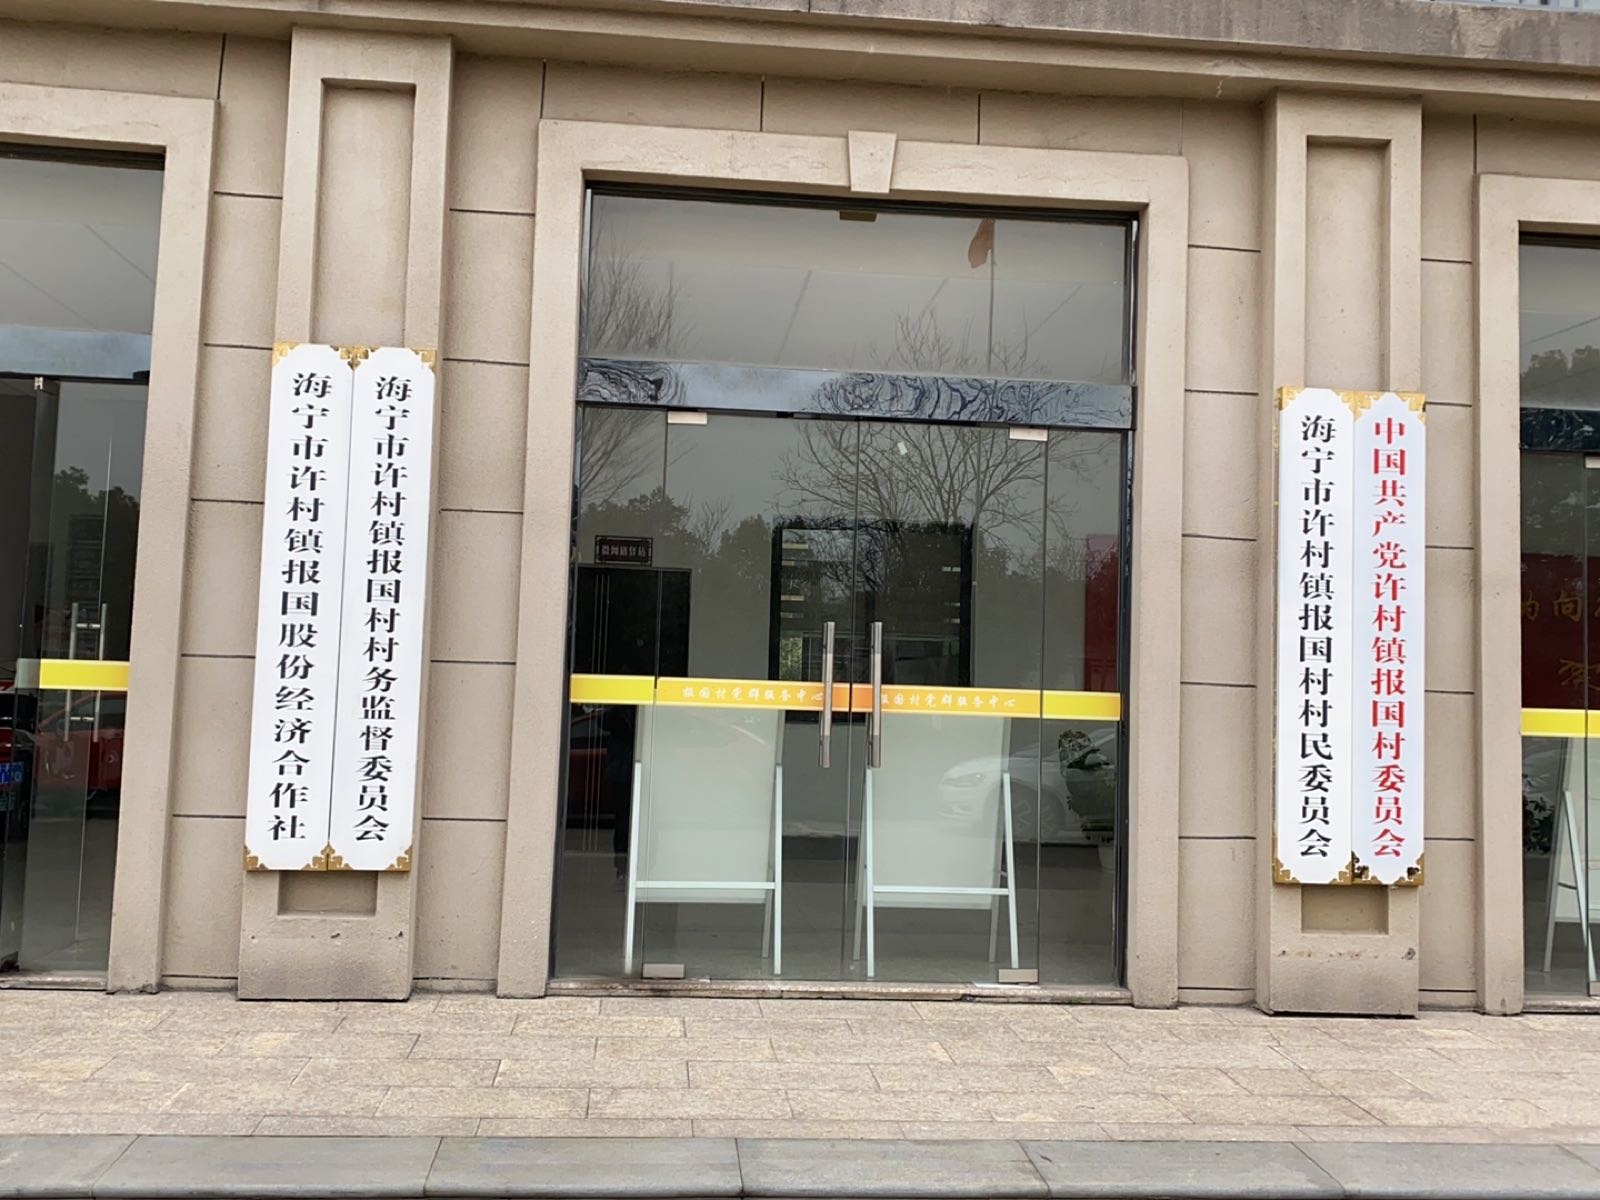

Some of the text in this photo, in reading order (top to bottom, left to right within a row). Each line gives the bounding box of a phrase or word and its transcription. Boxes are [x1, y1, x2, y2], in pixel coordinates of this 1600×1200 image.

[268, 371, 333, 841] 海宁市许村镇报国股份经济合作社
[354, 374, 413, 843] 海宁市许村镇报国村村务监督委员会
[1297, 414, 1337, 858] 海宁市许村镇报国村村民委员会
[1369, 416, 1407, 858] 中国共产党许村镇报国村委员会
